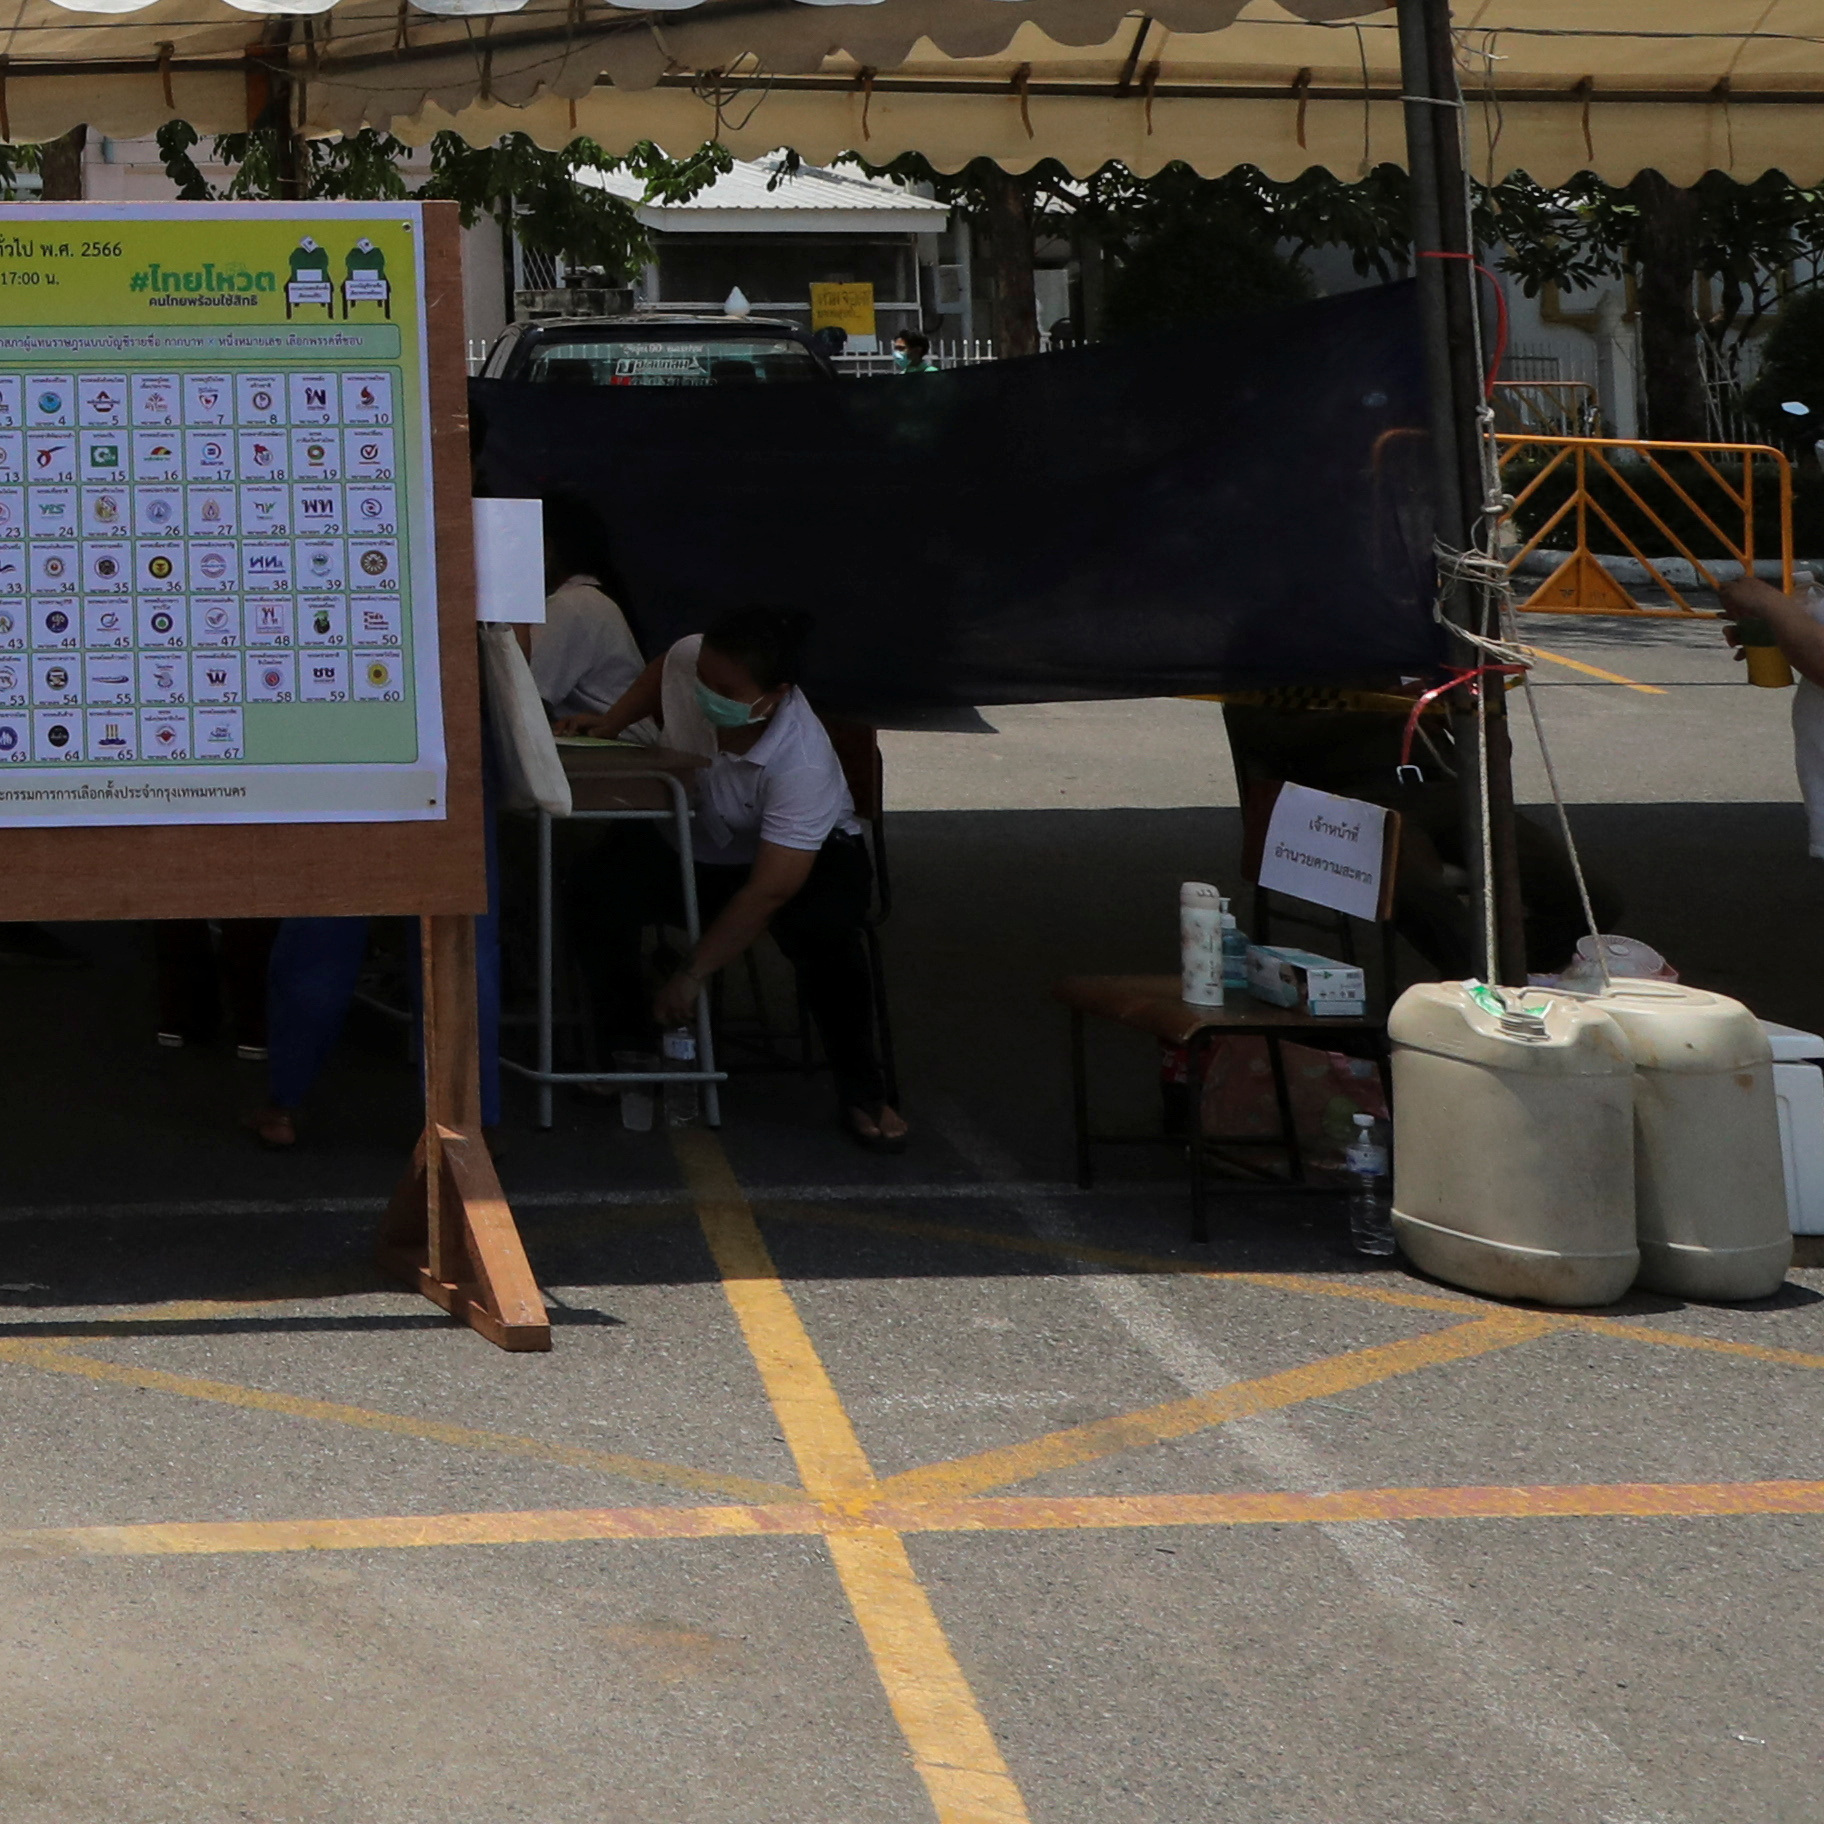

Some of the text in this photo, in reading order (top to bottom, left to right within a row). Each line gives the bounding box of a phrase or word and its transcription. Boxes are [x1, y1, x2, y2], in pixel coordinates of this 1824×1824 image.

[41, 243, 74, 258] พ.ศ.
[81, 241, 123, 258] 2566
[1, 273, 41, 286] 17:00
[6, 416, 13, 426] 3
[59, 416, 66, 425] 4
[112, 416, 118, 424] 5
[165, 416, 172, 424] 6
[218, 415, 224, 424] 7
[270, 415, 277, 424] 8
[323, 415, 330, 424] 9
[375, 414, 388, 423] 10
[5, 472, 19, 482] 13
[59, 472, 73, 481] 14
[111, 471, 125, 481] 15
[164, 471, 178, 480] 16
[217, 470, 231, 480] 17
[270, 470, 284, 479] 18
[323, 470, 337, 479] 19
[376, 469, 391, 479] 20
[6, 528, 20, 537] 23
[59, 527, 73, 536] 24
[112, 527, 127, 536] 25
[165, 526, 180, 535] 26
[218, 526, 233, 535] 27
[271, 526, 286, 535] 28
[324, 525, 339, 534] 29
[378, 524, 393, 534] 30
[7, 584, 22, 593] 33
[61, 583, 74, 592] 34
[114, 583, 128, 593] 35
[167, 582, 181, 591] 36
[220, 581, 235, 590] 37
[273, 580, 288, 590] 38
[326, 580, 341, 589] 39
[380, 580, 395, 589] 40
[8, 639, 24, 649] 43
[62, 639, 76, 647] 44
[115, 637, 129, 647] 45
[168, 637, 183, 646] 46
[221, 636, 236, 646] 47
[275, 636, 290, 646] 48
[328, 635, 343, 645] 49
[383, 635, 398, 644] 50
[10, 696, 25, 705] 53
[63, 695, 77, 704] 54
[117, 694, 131, 704] 55
[170, 693, 184, 703] 56
[223, 693, 237, 702] 57
[277, 692, 292, 702] 58
[331, 691, 345, 701] 59
[384, 691, 399, 701] 60
[11, 752, 26, 762] 63
[65, 751, 79, 760] 64
[118, 750, 133, 760] 65
[171, 749, 186, 759] 66
[225, 749, 239, 759] 67
[1310, 815, 1360, 843] เจ้าหน้าที่
[1275, 842, 1372, 884] อำนวยความสะดวก
